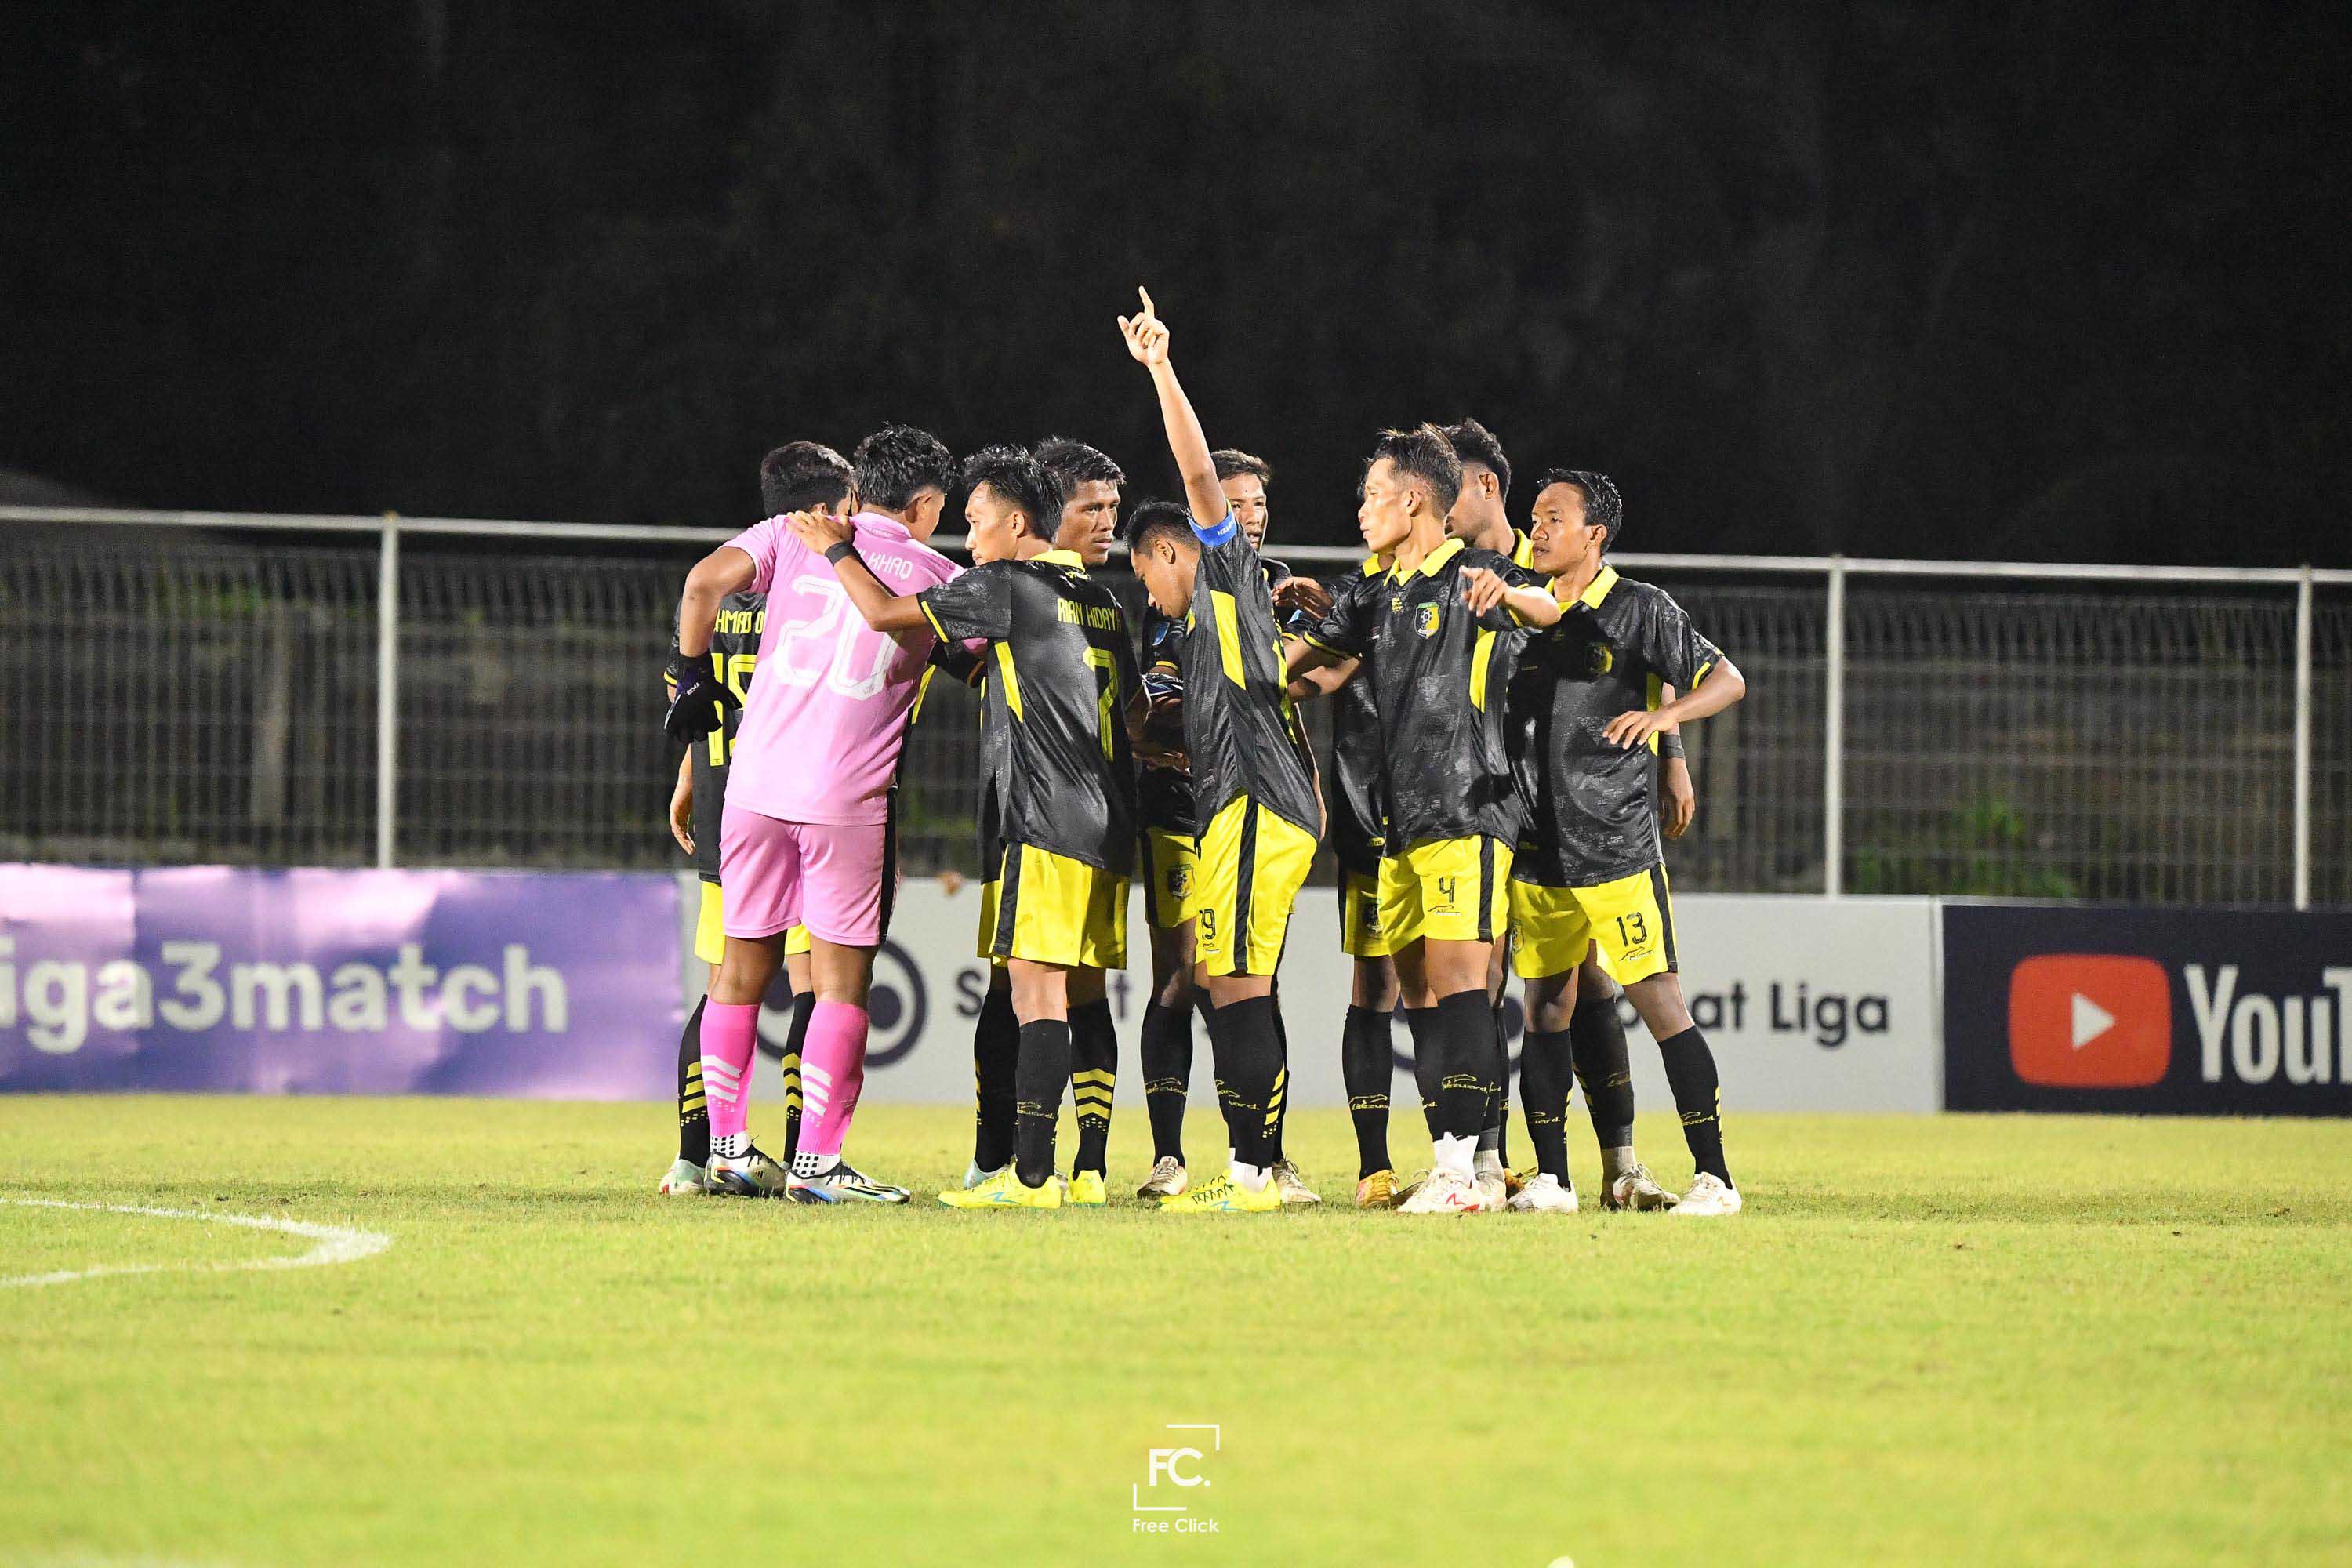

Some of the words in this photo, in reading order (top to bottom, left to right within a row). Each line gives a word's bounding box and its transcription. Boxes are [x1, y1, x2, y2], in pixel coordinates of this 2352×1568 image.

[713, 608, 752, 634] HMAD
[1057, 597, 1084, 626] RIAN
[772, 574, 898, 702] 20
[1082, 646, 1119, 764] 7
[1439, 877, 1456, 904] 4
[1616, 912, 1647, 947] 13
[1770, 982, 1888, 1049] Liga
